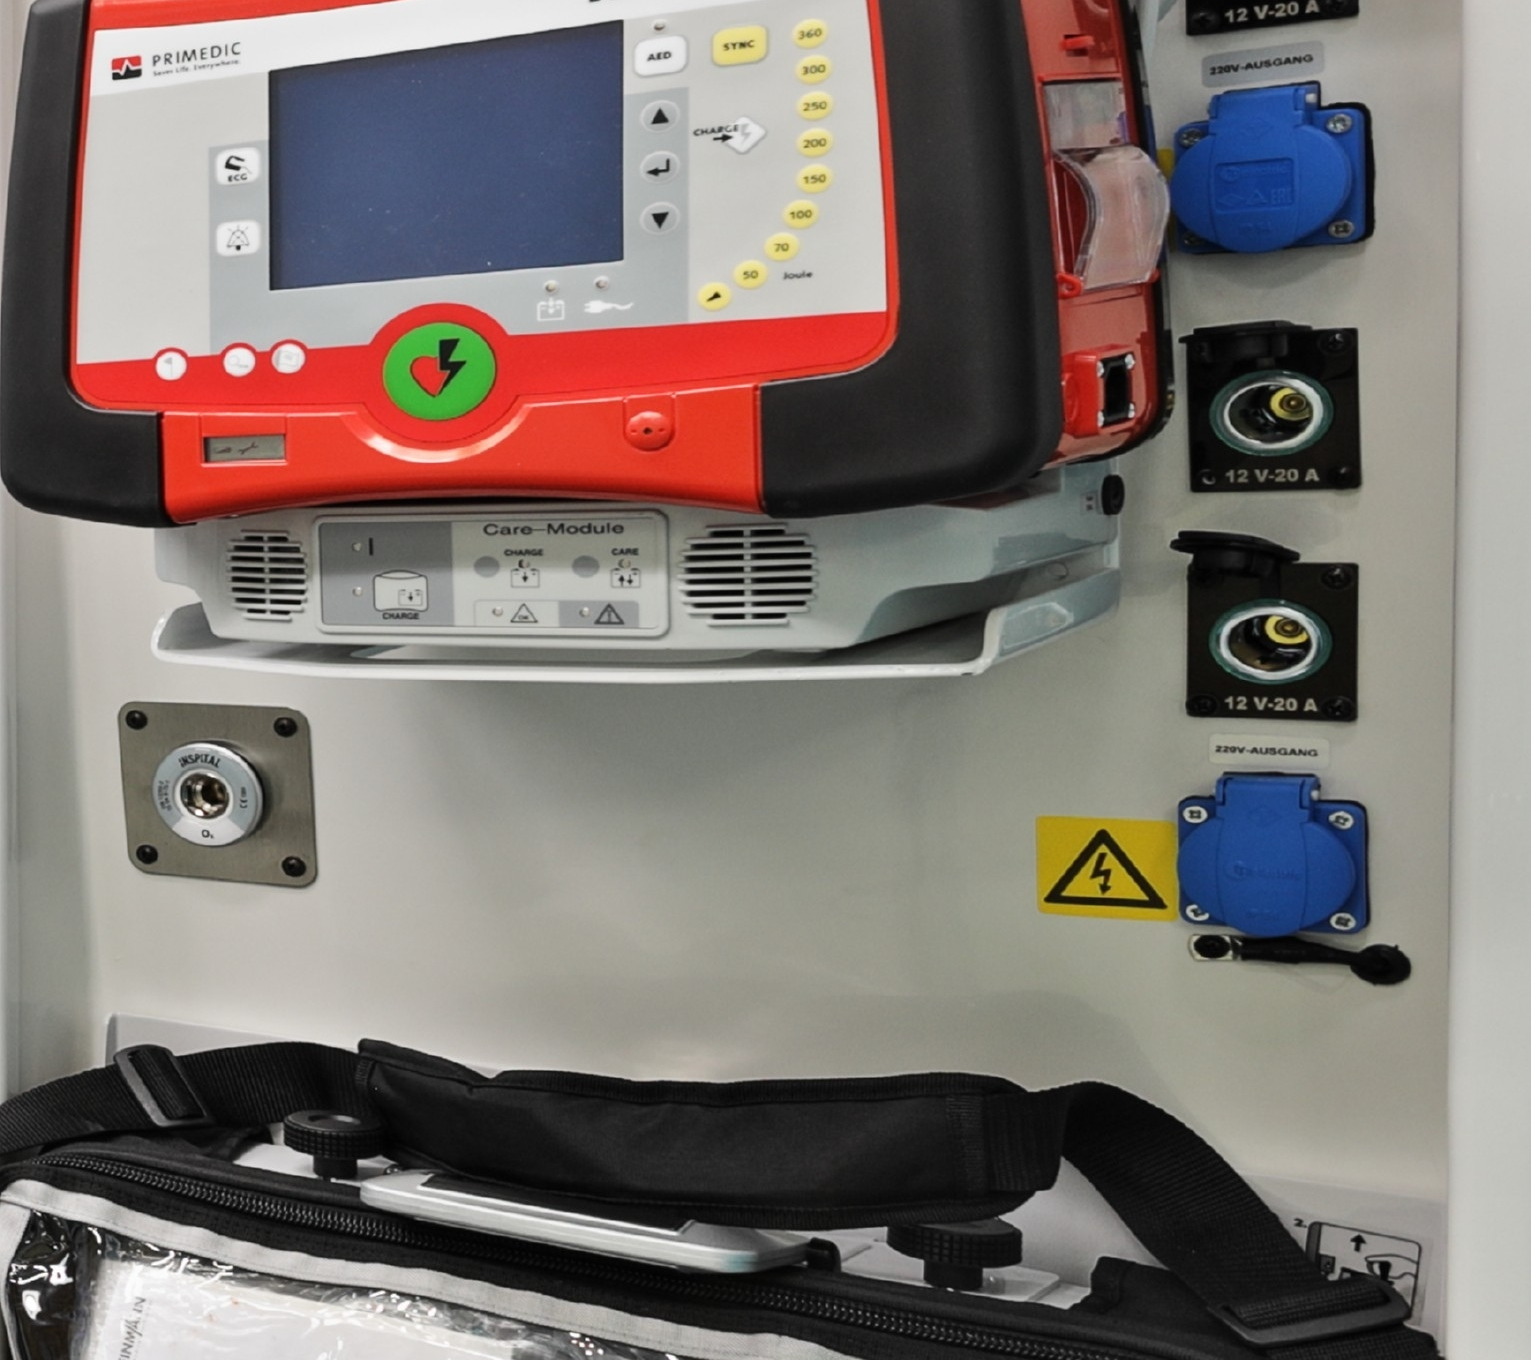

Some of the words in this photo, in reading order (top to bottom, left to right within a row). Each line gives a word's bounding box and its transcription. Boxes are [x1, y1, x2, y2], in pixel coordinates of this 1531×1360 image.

[1225, 8, 1250, 23] 12
[1254, 2, 1300, 21] V-20
[1305, 0, 1320, 14] A
[797, 28, 822, 39] 360
[723, 40, 755, 51] SYNC
[151, 41, 242, 68] PRIMEDIC
[647, 51, 673, 62] AED
[801, 64, 827, 75] 300
[1209, 52, 1314, 75] 220V-AUSGANG
[802, 100, 828, 112] 250
[693, 123, 739, 138] CHARGE
[802, 137, 828, 149] 200
[802, 173, 827, 185] 150
[789, 209, 813, 220] 100
[774, 242, 790, 253] 70
[742, 270, 759, 280] 50
[783, 269, 814, 281] Joule
[1225, 469, 1248, 484] 12
[1253, 469, 1299, 484] V-20
[1304, 468, 1320, 483] A
[482, 522, 625, 537] Care-Module
[504, 548, 544, 557] CHARGE
[611, 547, 639, 556] CARE
[382, 612, 420, 621] CHARGE
[1225, 697, 1247, 712] 12
[1254, 696, 1298, 712] V-20
[1303, 697, 1318, 712] A
[1215, 744, 1318, 758] 220V-AUSGANG
[178, 753, 221, 769] INSPITAL
